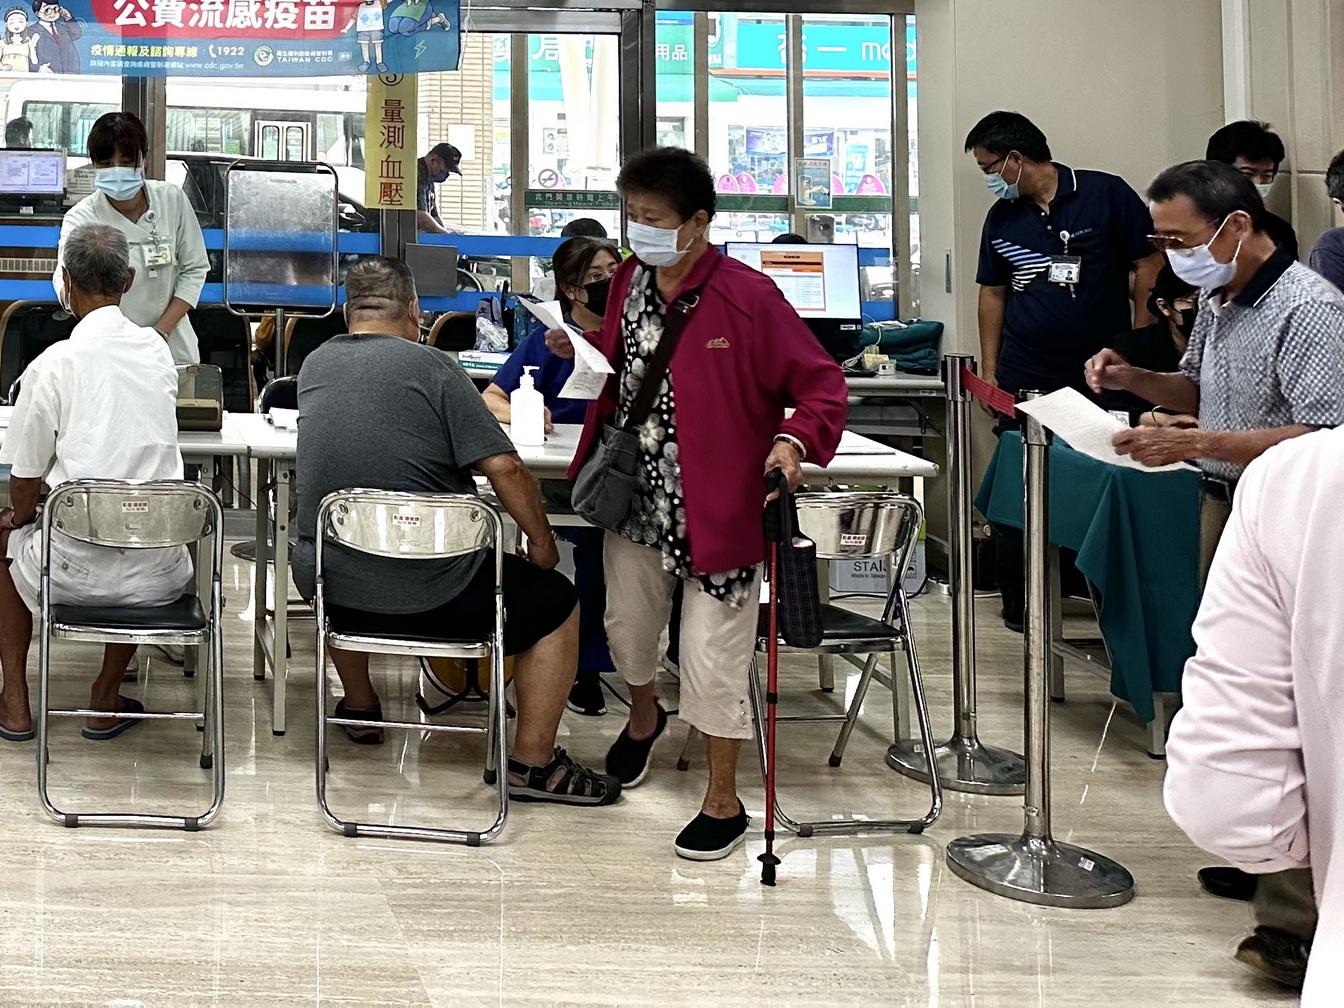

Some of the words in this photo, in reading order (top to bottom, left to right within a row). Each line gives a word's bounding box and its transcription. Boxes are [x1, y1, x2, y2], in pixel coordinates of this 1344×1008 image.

[217, 46, 245, 57] 1922
[378, 99, 405, 206] 量測血壓
